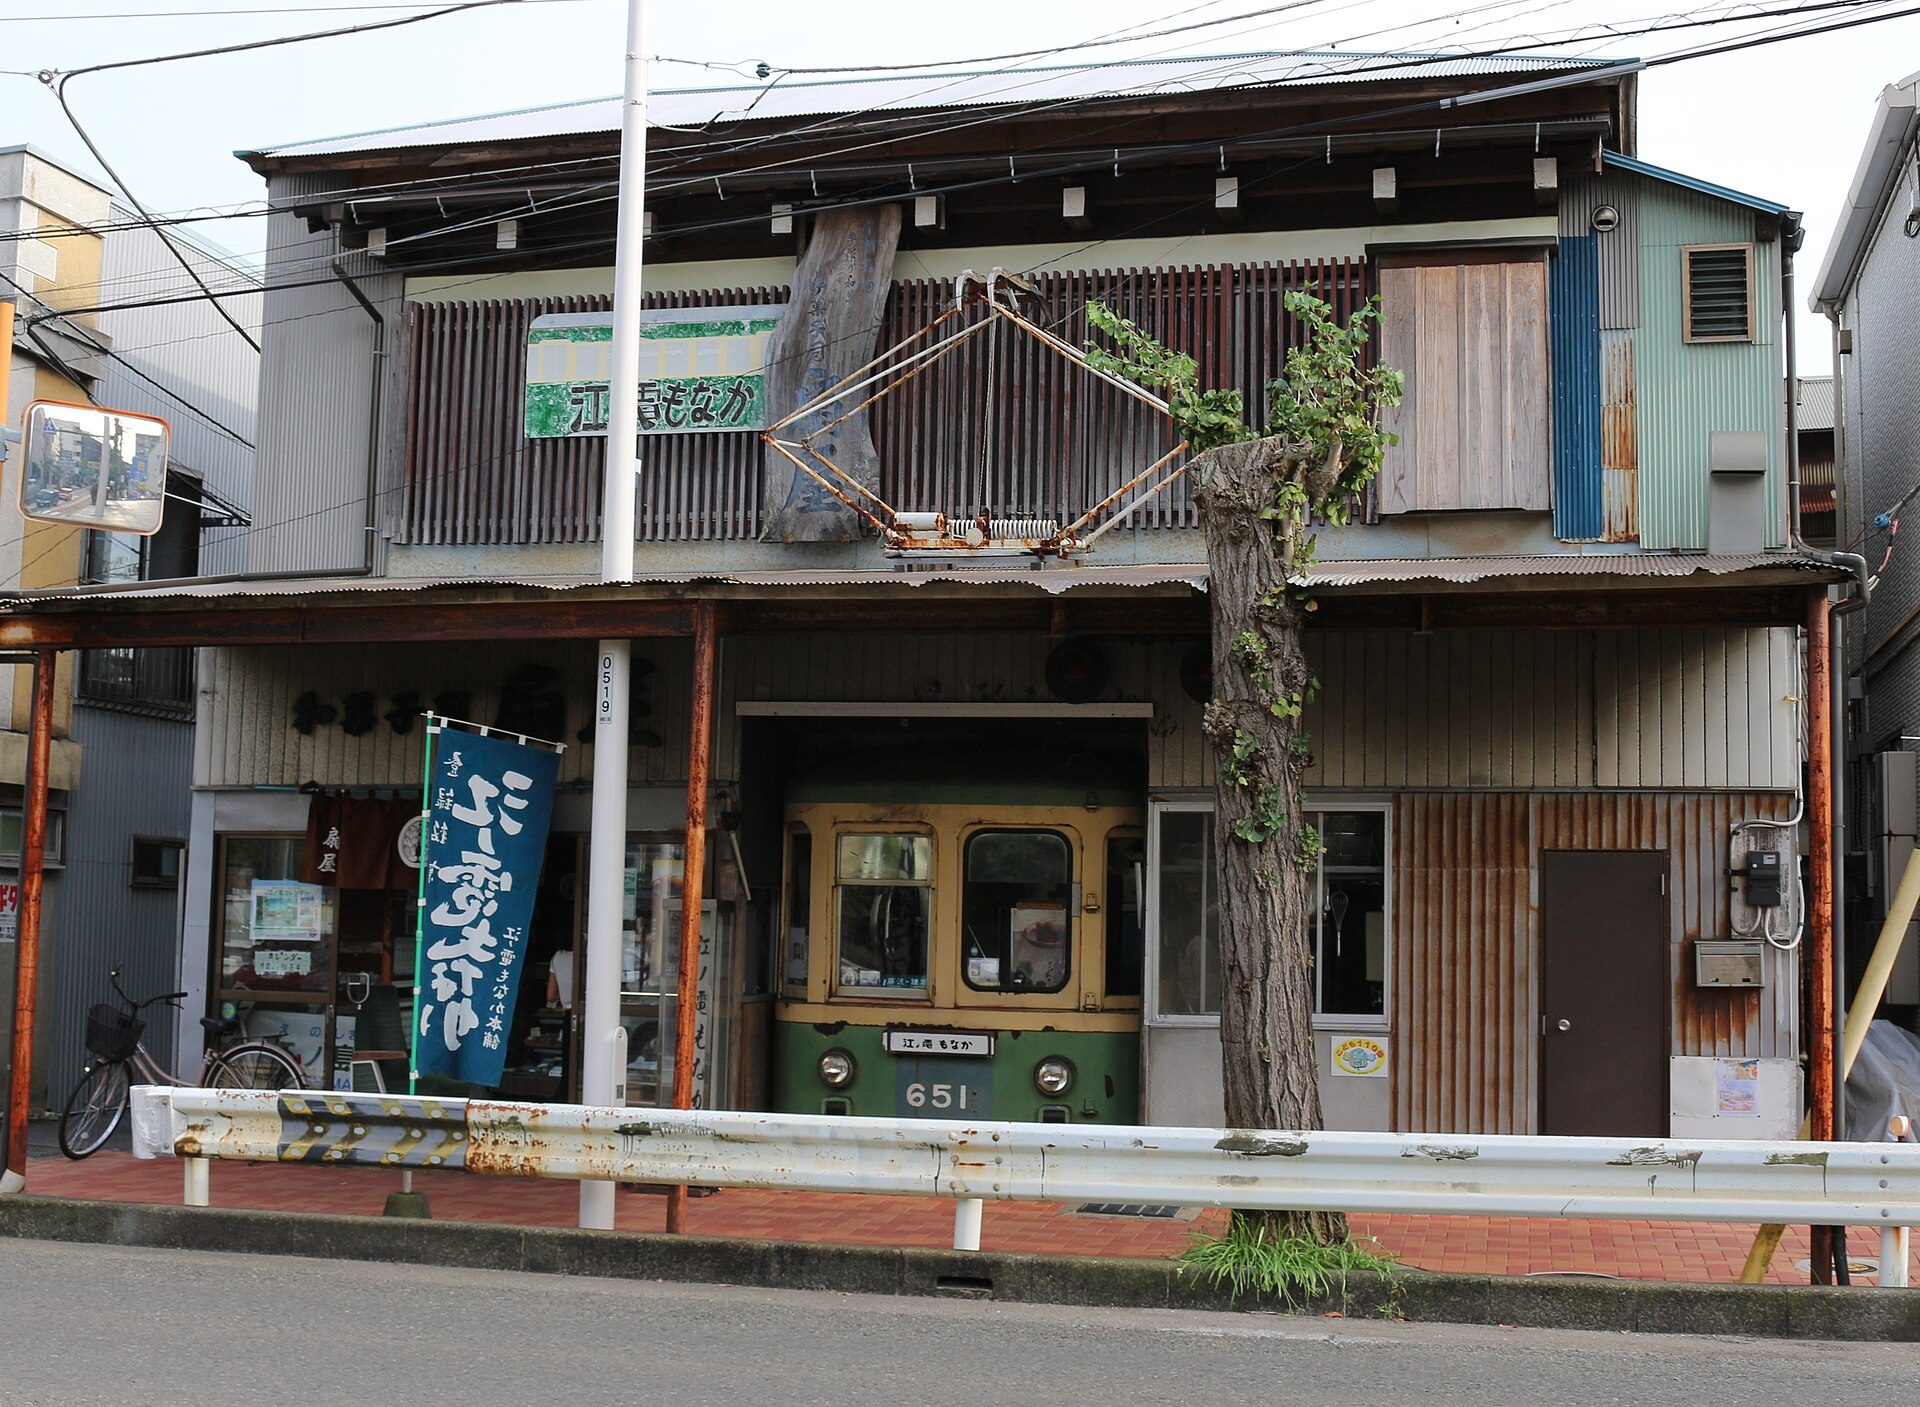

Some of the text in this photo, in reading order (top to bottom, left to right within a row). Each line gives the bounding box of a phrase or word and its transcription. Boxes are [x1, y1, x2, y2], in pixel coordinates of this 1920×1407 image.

[570, 379, 755, 432] 江電もなか
[602, 656, 612, 713] 0519
[316, 826, 341, 873] 扇屋
[906, 1083, 967, 1110] 651
